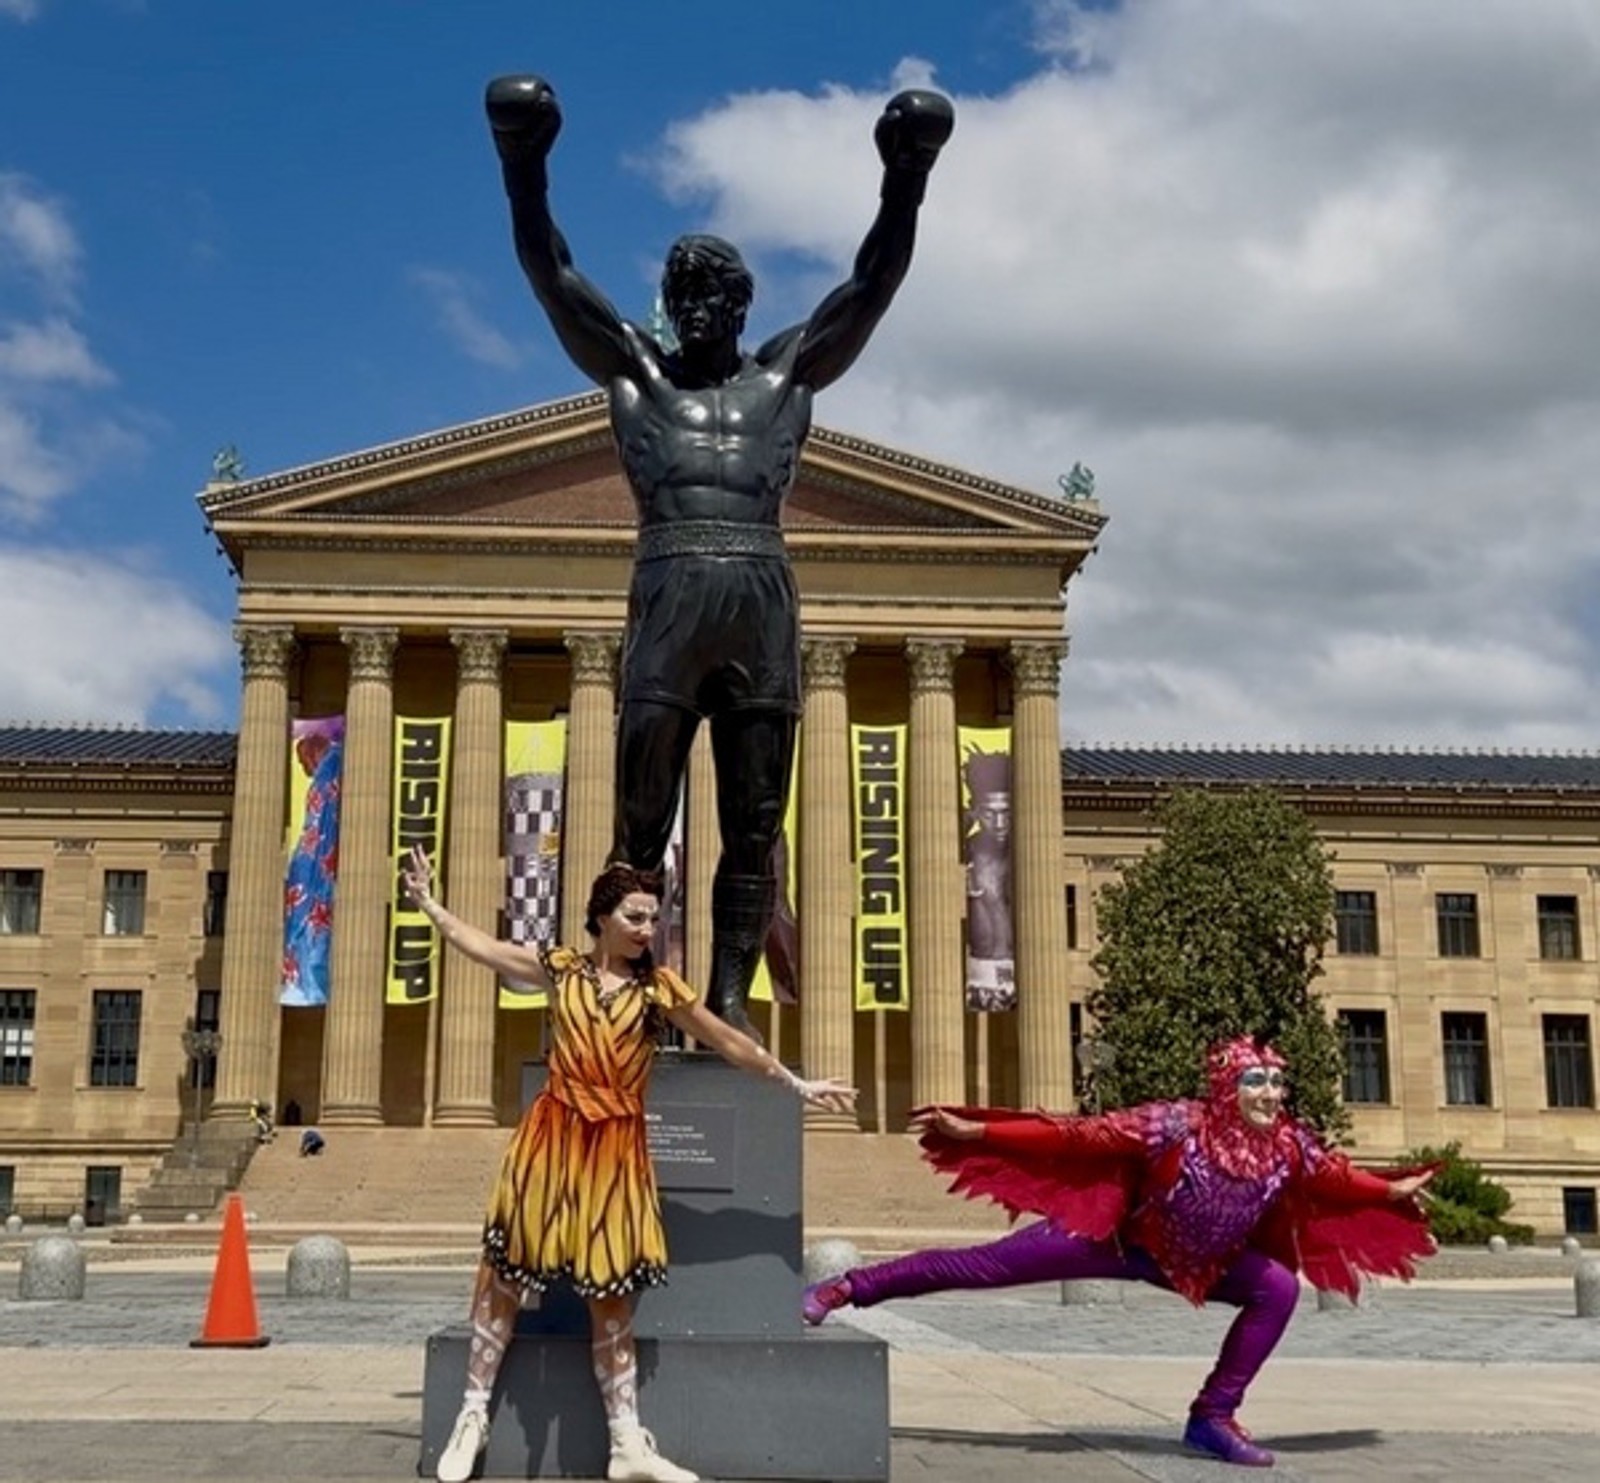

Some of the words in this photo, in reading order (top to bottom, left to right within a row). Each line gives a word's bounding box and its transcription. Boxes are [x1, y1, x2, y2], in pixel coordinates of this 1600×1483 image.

[858, 731, 900, 915] RISING
[394, 926, 432, 999] UP
[862, 928, 901, 1003] UP
